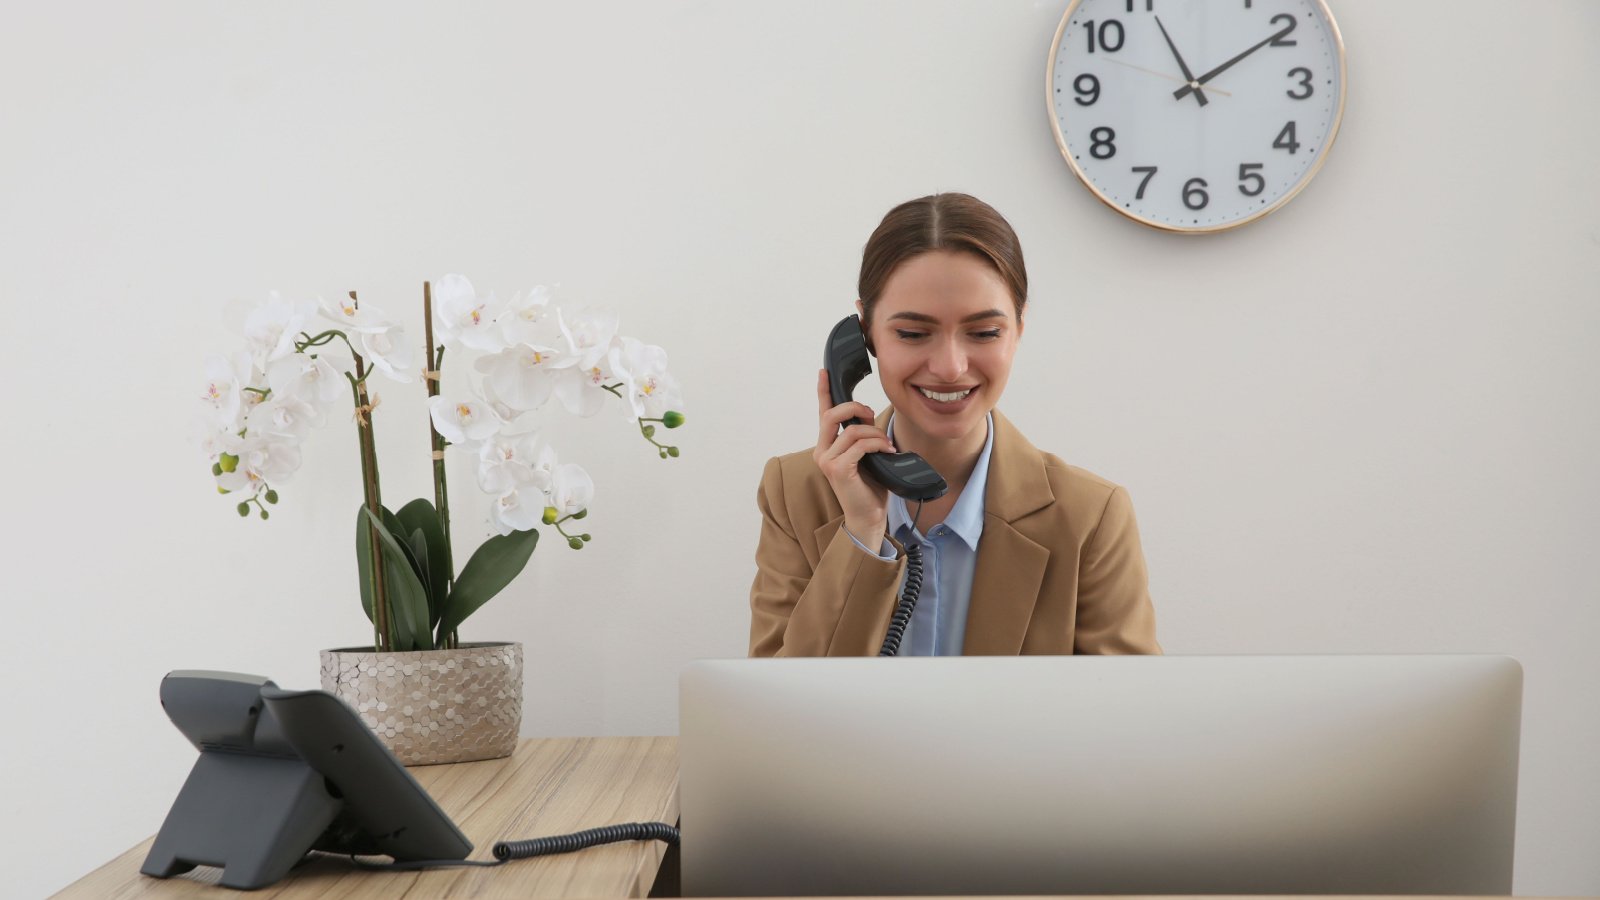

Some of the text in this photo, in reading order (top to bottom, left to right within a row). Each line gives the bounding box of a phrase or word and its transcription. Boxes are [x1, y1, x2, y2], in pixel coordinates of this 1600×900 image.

[1082, 19, 1125, 53] 10
[1269, 13, 1298, 47] 2
[1073, 73, 1101, 107] 9
[1286, 67, 1314, 100] 3
[1089, 126, 1117, 160] 8
[1272, 121, 1300, 155] 4
[1131, 166, 1158, 200] 7
[1182, 178, 1209, 211] 6
[1238, 163, 1266, 197] 5
